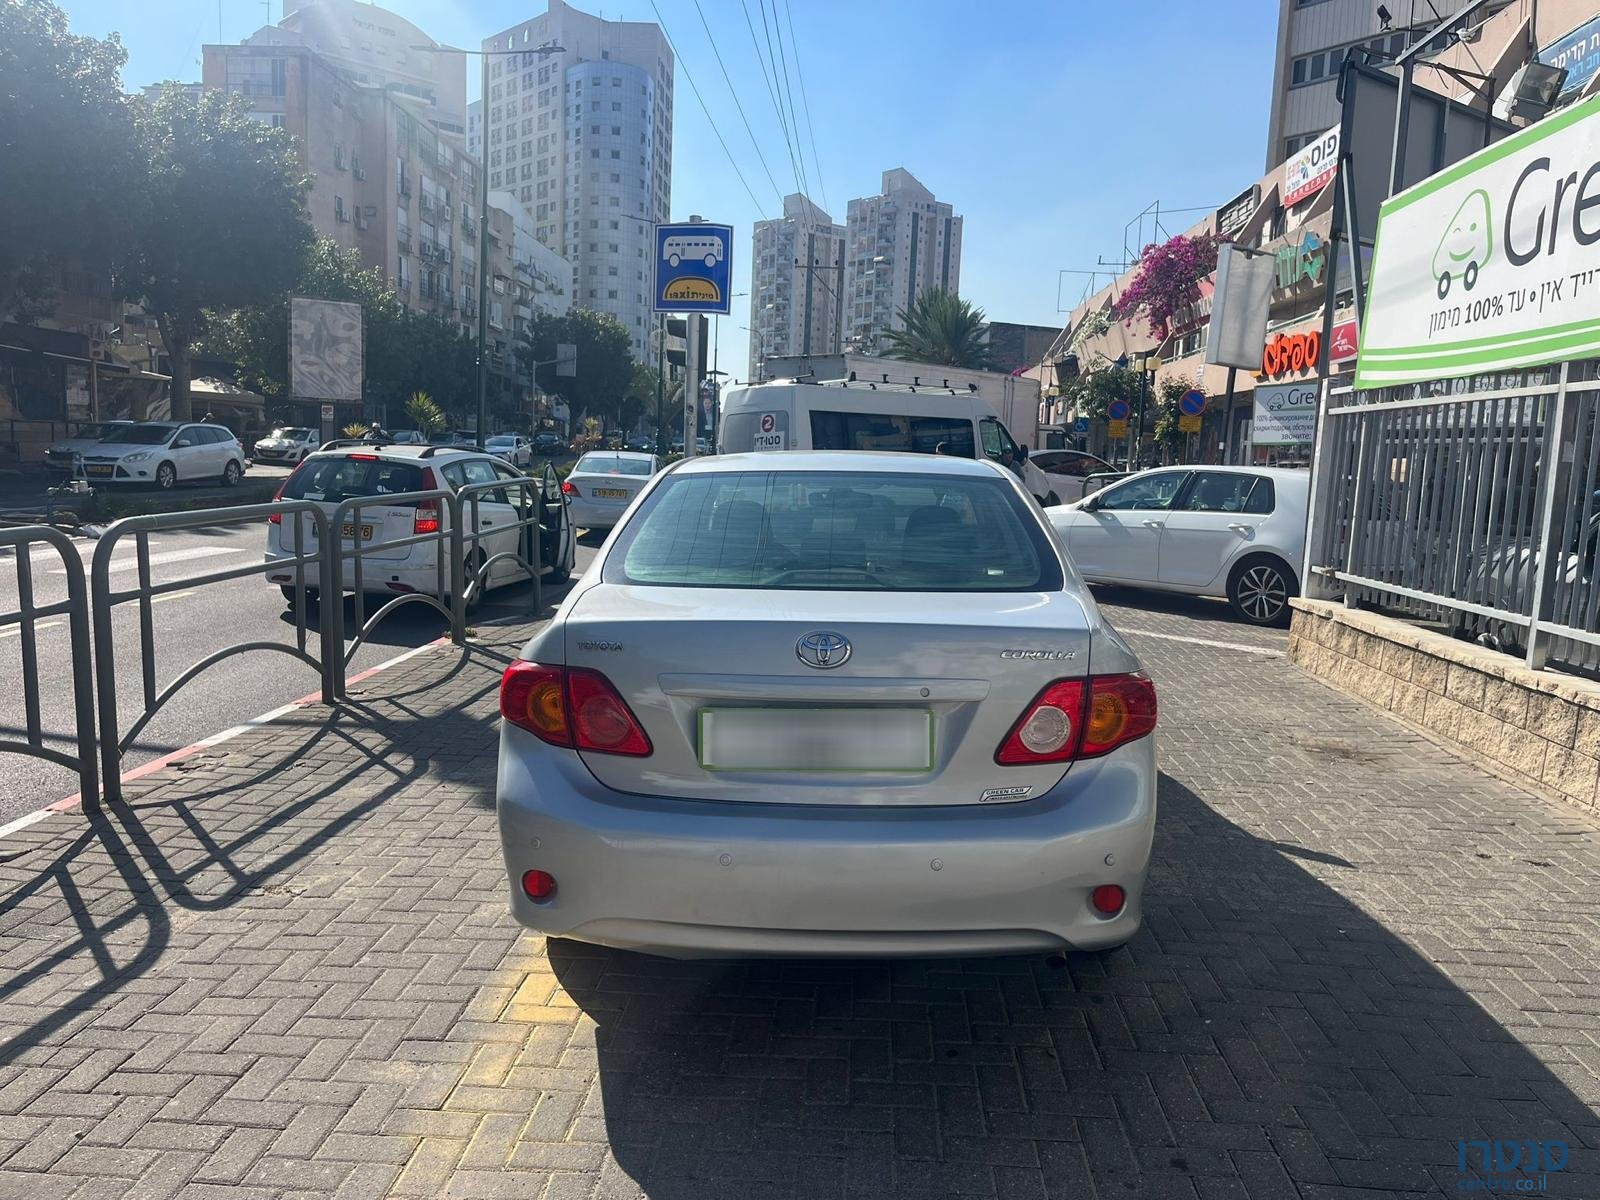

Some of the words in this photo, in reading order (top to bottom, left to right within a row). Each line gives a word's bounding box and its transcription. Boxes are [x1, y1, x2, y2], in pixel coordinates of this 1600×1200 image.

[1508, 288, 1527, 313] עד
[1539, 277, 1564, 313] אין
[1464, 293, 1503, 324] 100%
[1428, 306, 1460, 339] מימון
[1288, 388, 1317, 405] Gre
[764, 416, 773, 429] 2
[577, 640, 624, 651] TOYOTA
[1000, 649, 1076, 660] COROLLA
